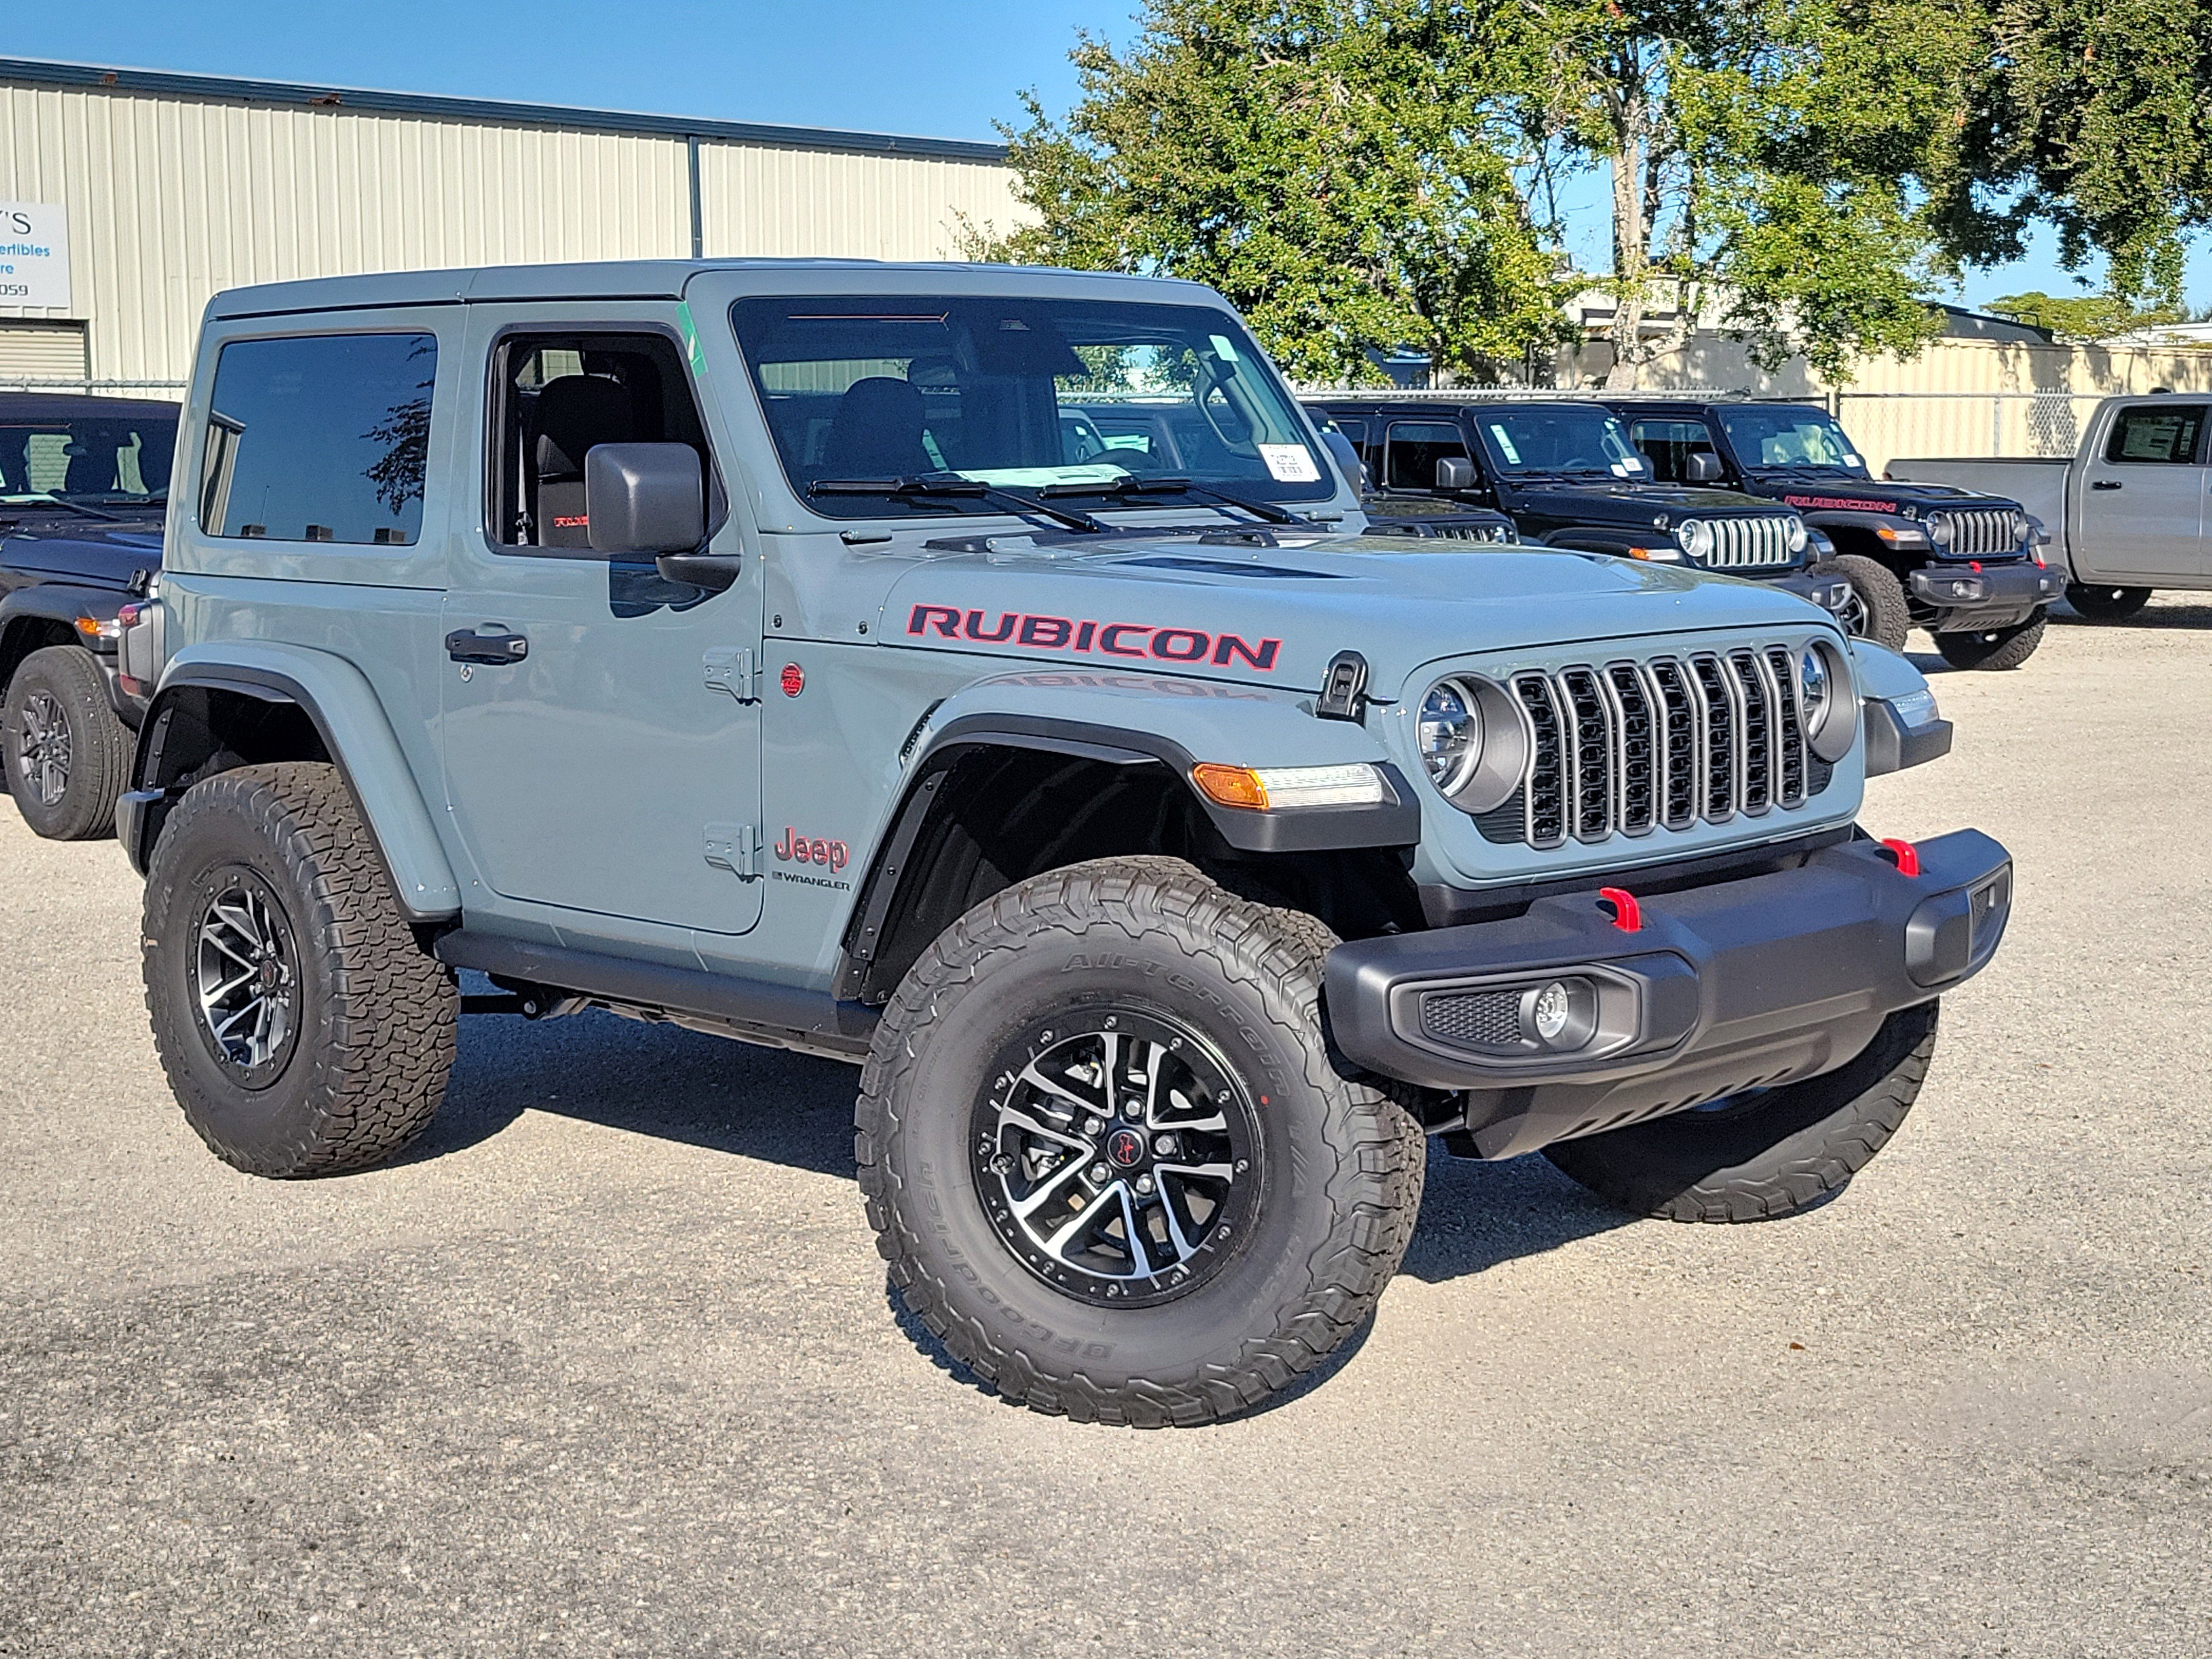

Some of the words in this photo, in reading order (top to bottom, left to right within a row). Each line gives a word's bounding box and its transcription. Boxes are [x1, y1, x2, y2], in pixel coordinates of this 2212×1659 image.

[1784, 495, 1897, 512] RUBICON
[906, 603, 1283, 671] RUBICON
[774, 825, 849, 874] Jeep
[783, 872, 850, 891] WRANGLER
[917, 1161, 1118, 1362] BFGoodrich
